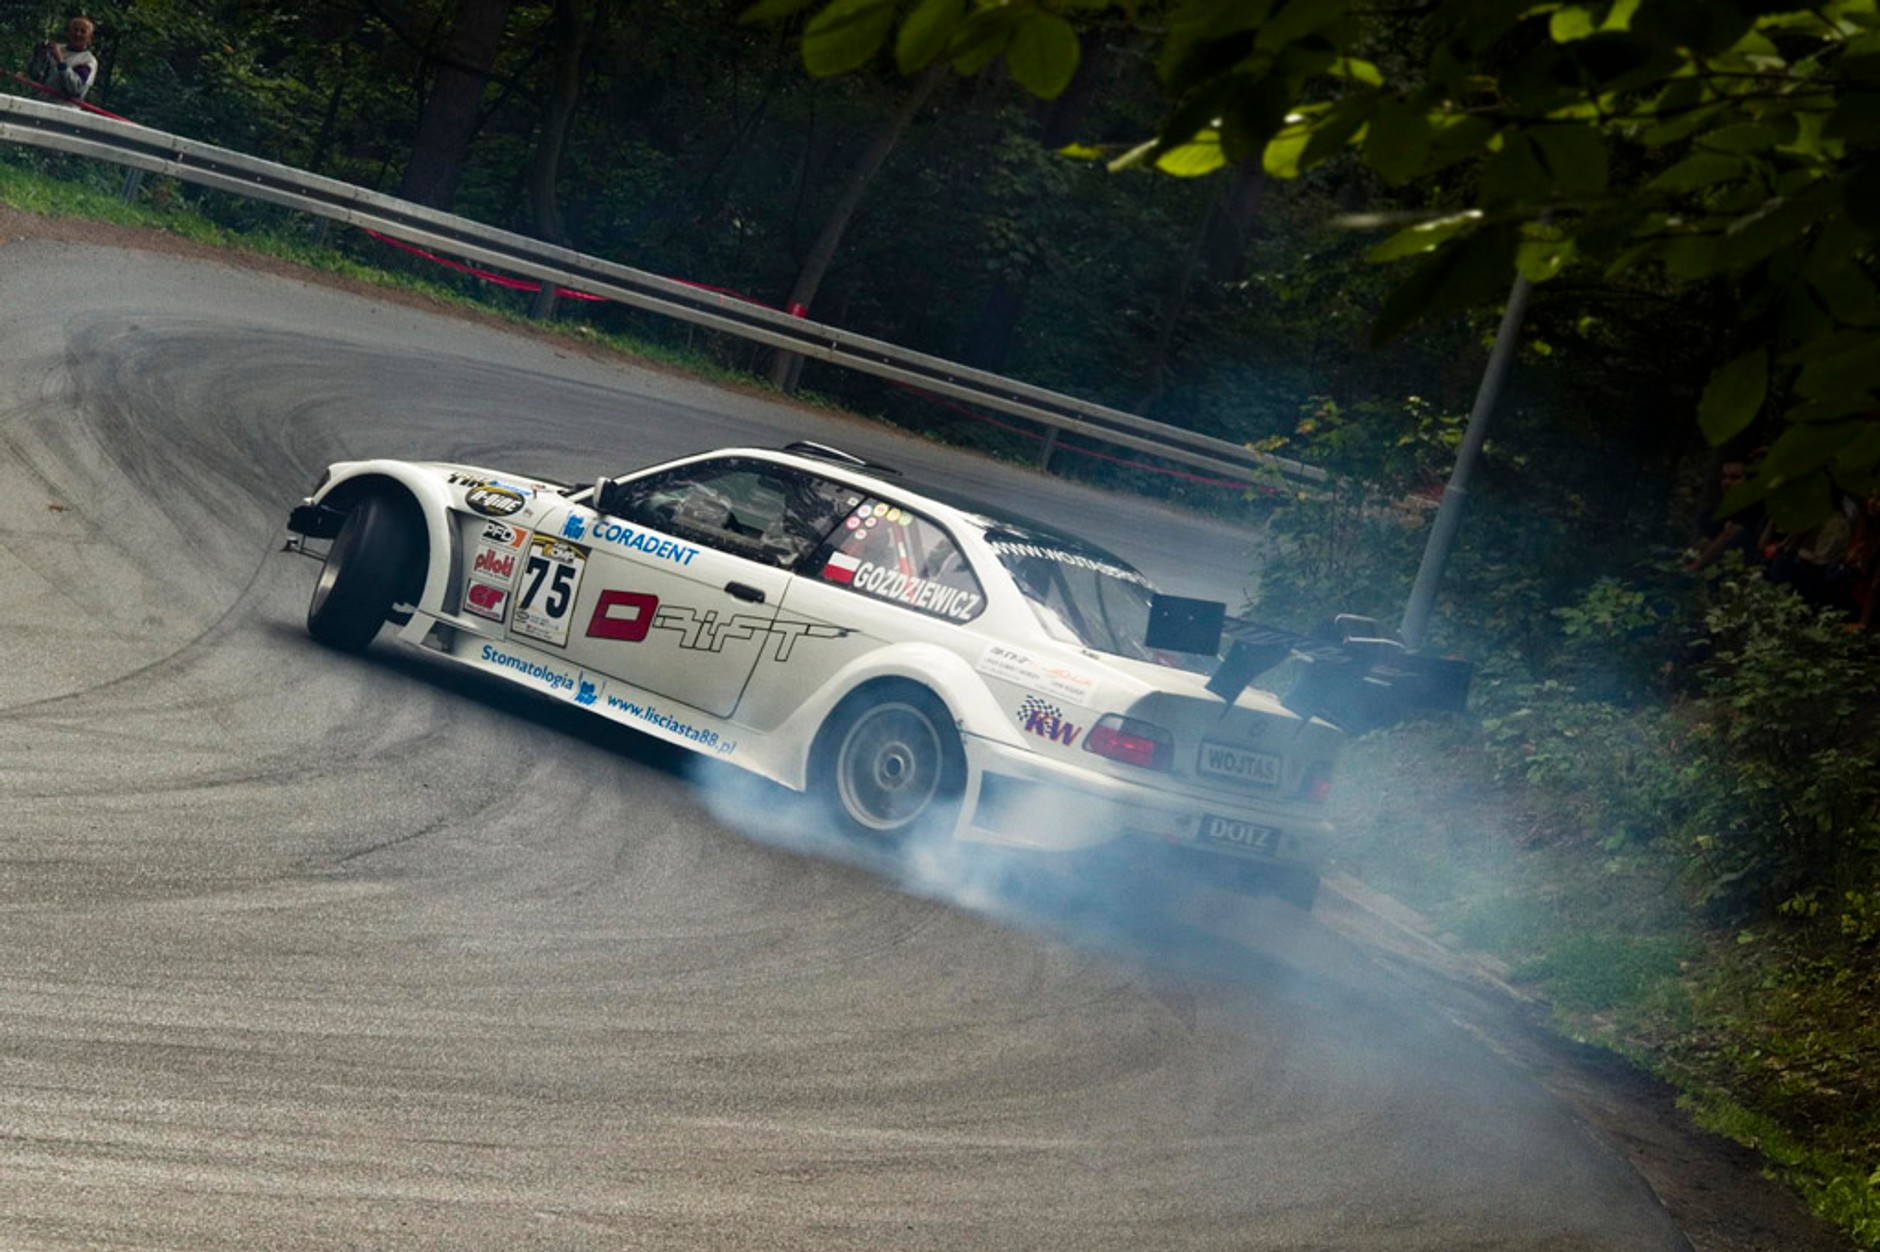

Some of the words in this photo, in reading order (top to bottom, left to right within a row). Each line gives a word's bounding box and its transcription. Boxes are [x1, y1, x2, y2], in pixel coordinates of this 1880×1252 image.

[592, 521, 700, 566] CORADENT
[519, 556, 576, 618] 75
[481, 644, 574, 690] Stomatologia
[607, 694, 736, 755] www.lisciasta88.pl
[1024, 708, 1083, 747] KW
[1208, 749, 1275, 780] WOJTAS
[1209, 818, 1268, 848] DOTZ
